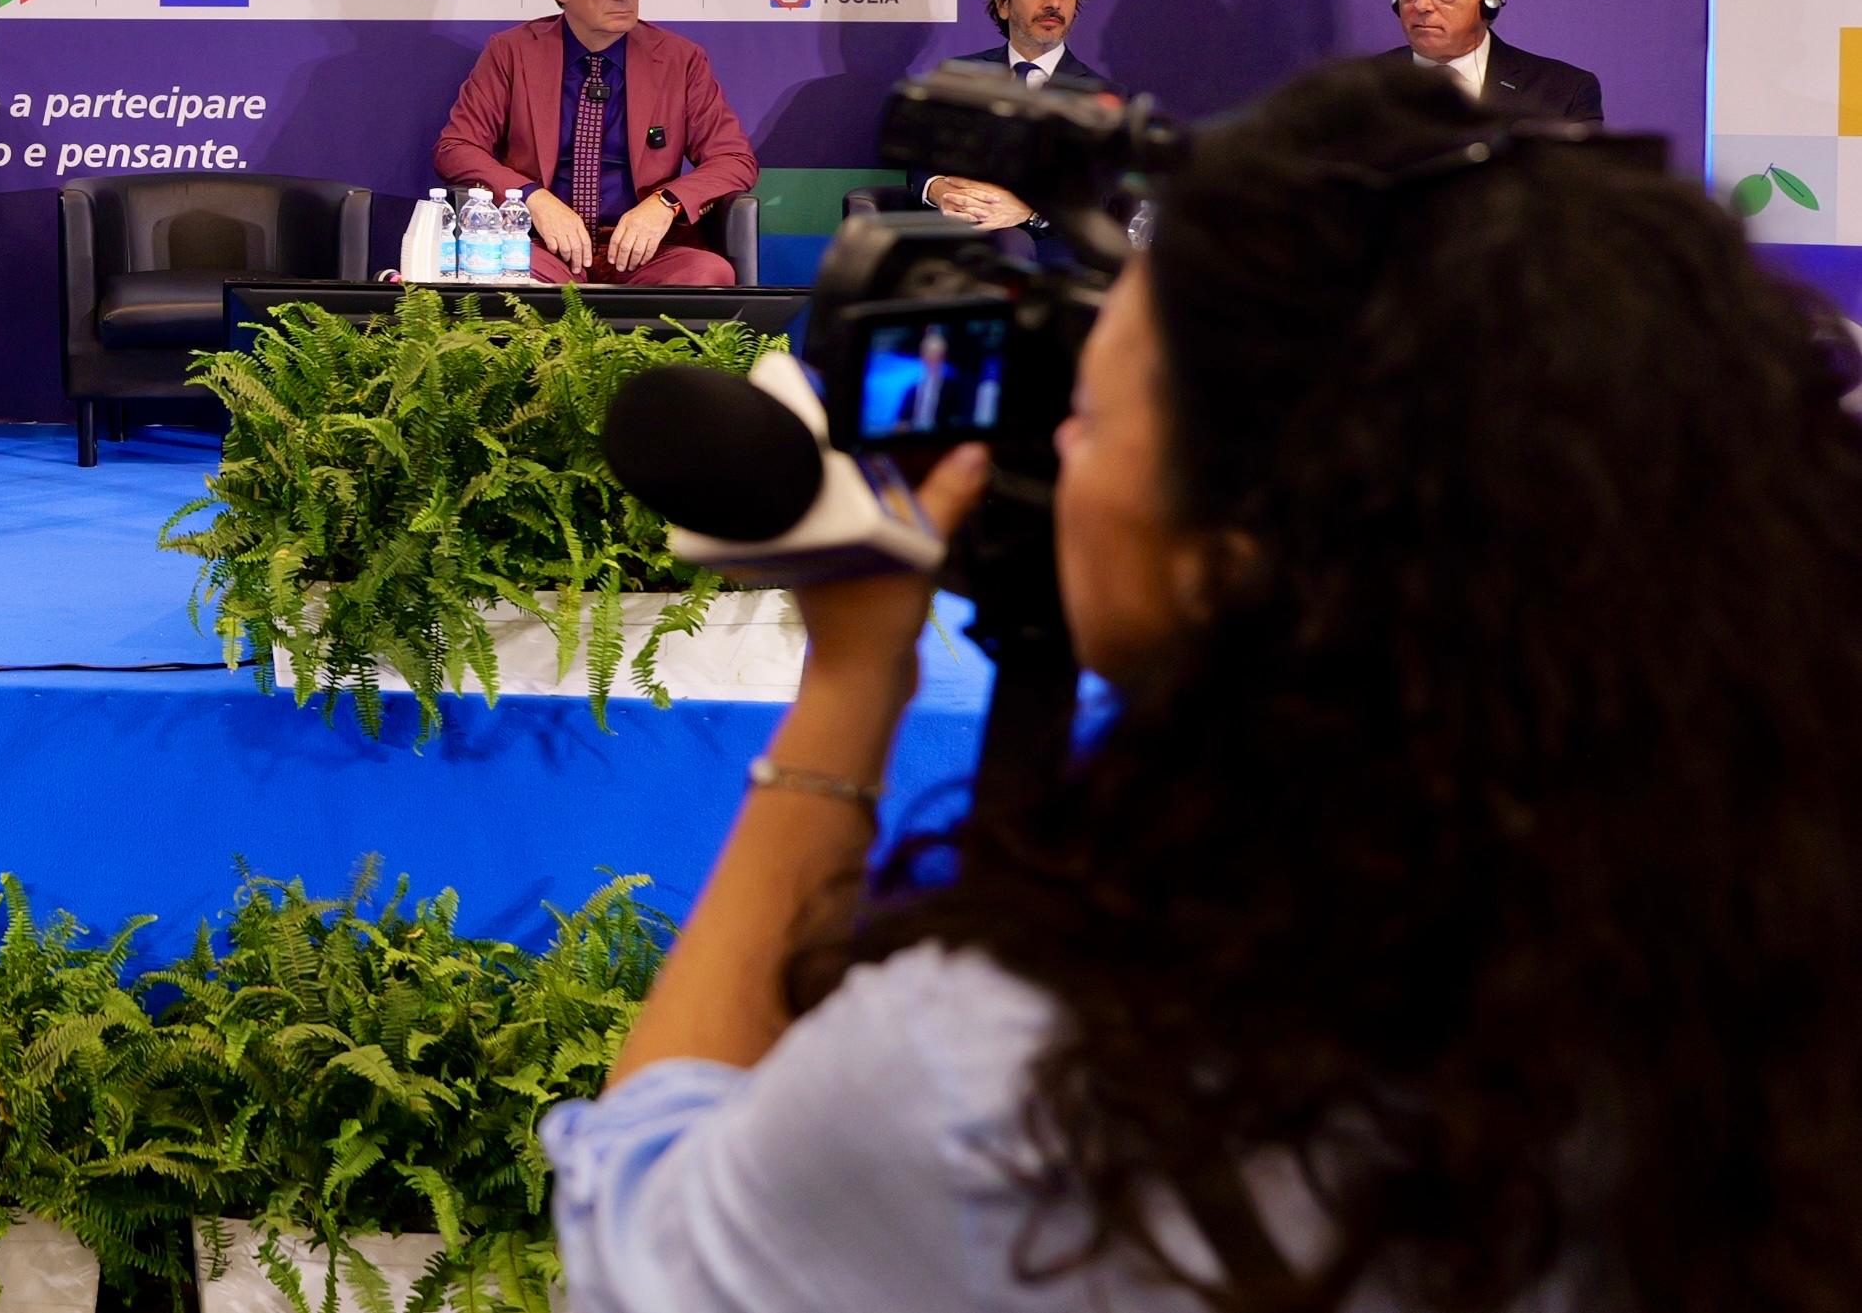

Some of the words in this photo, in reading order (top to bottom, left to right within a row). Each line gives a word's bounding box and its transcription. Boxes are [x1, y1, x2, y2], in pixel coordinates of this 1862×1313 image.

[9, 93, 32, 119] a
[42, 85, 267, 127] partecipare
[23, 143, 47, 167] e
[56, 138, 249, 176] pensante.
